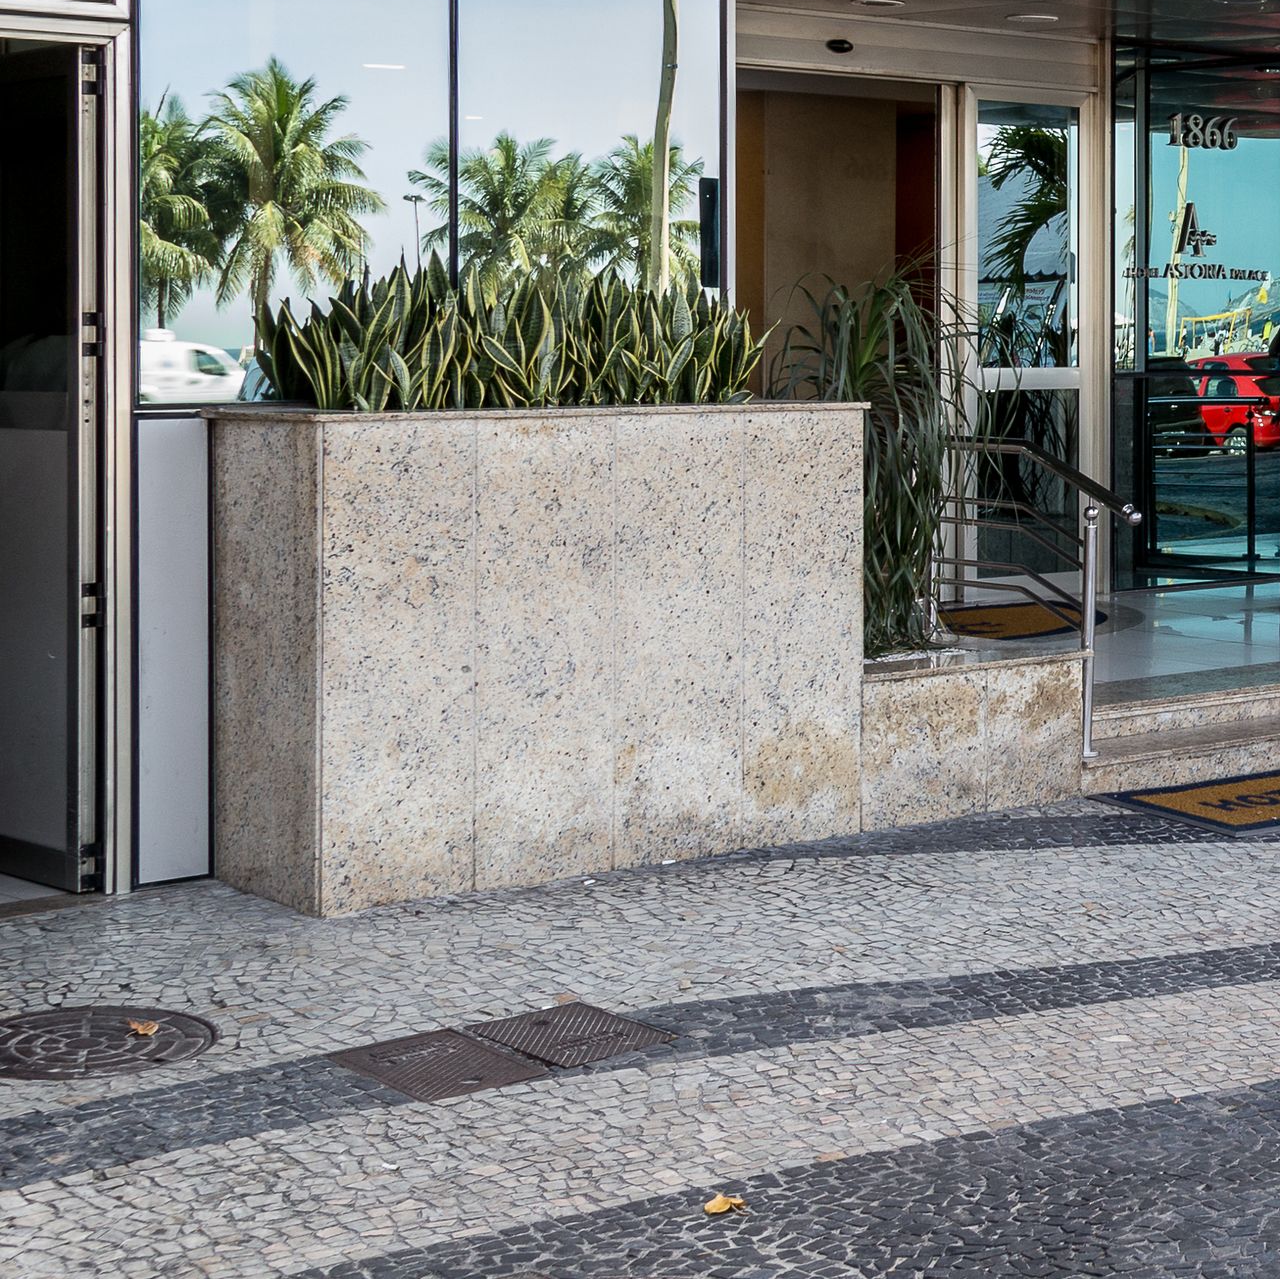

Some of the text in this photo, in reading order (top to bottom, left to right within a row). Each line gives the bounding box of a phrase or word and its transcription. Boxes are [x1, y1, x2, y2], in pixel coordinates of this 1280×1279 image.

[1166, 112, 1238, 151] 1866
[1162, 263, 1227, 280] ASTORIA
[1229, 268, 1270, 282] PALACE
